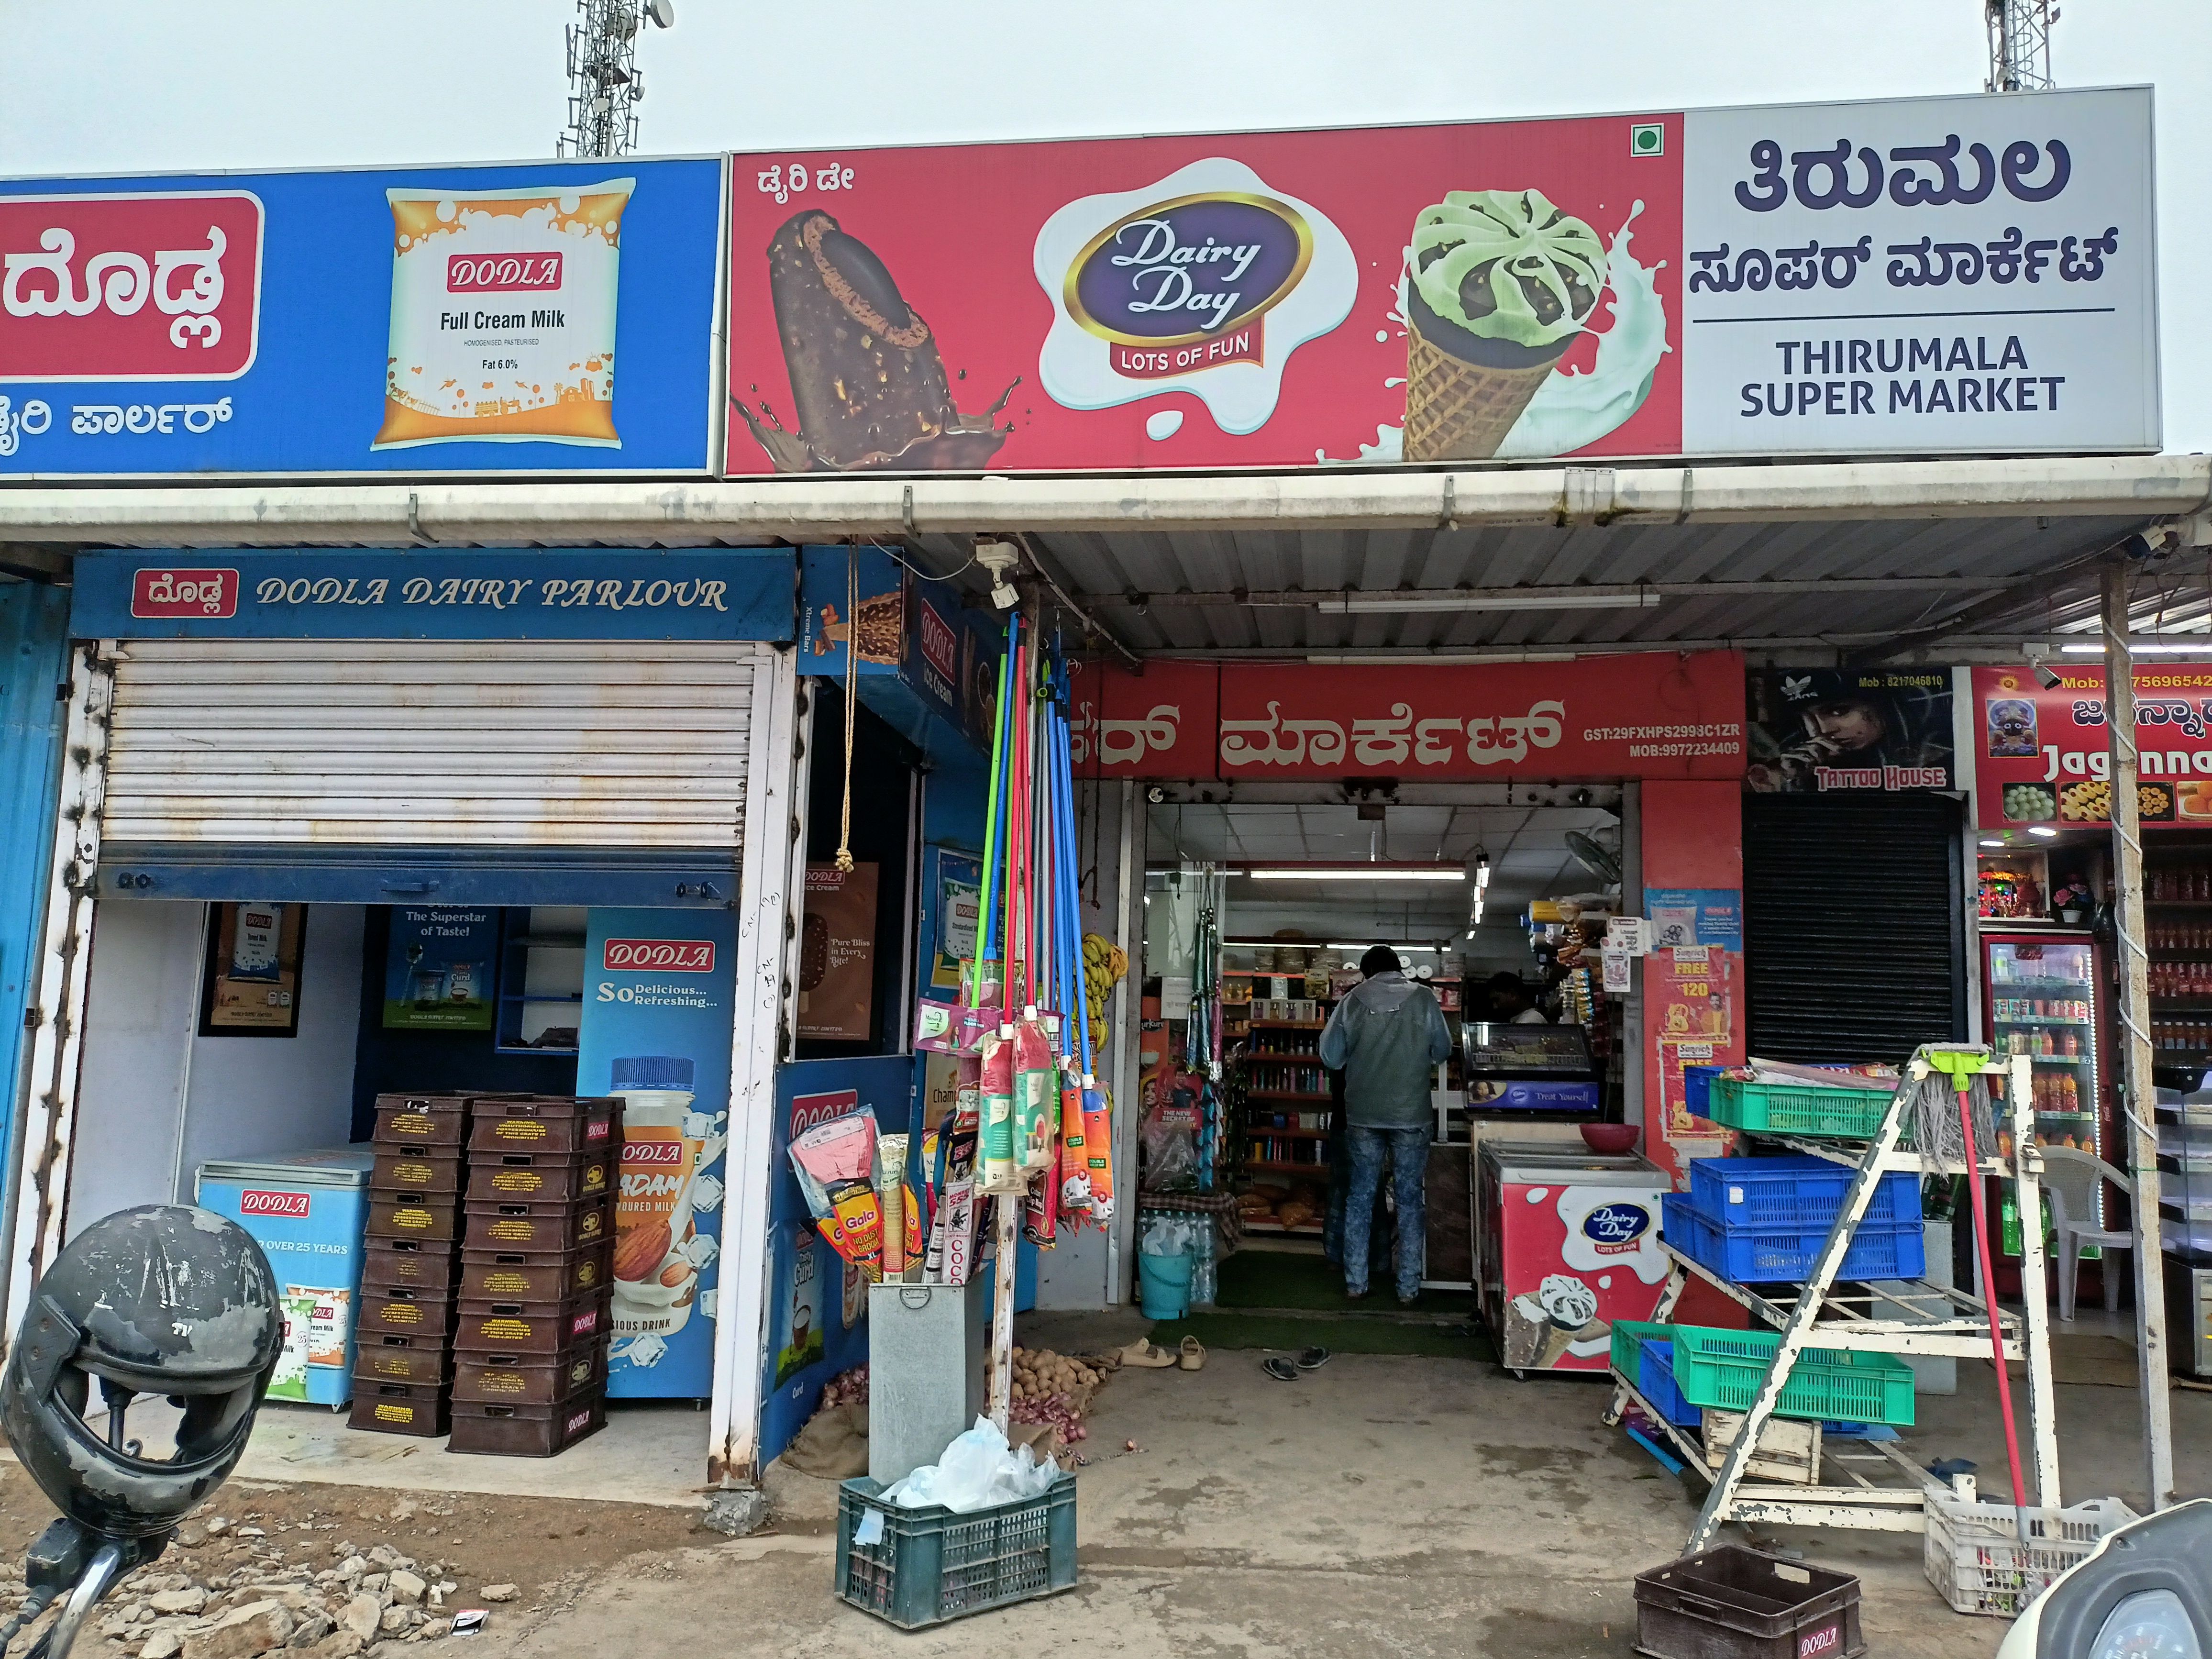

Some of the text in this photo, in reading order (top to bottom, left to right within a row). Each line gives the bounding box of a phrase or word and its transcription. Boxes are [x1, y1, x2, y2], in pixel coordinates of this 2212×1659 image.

[757, 162, 855, 204] ಡೈರಿ ಡೇ
[1734, 134, 2071, 212] ತಿರುಮಲ
[1111, 219, 1261, 282] Dairy
[1689, 226, 2119, 294] ಸೂಪರ್ ಮಾರ್ಕೆಟ್
[451, 258, 559, 286] DODLA
[3, 225, 226, 348] ದೊಡ್ಲ
[1128, 265, 1240, 330] Day
[441, 310, 565, 330] Full Cream Milk
[1121, 332, 1249, 371] LOTS OF FUN
[1776, 335, 2028, 375] THIRUMALA
[482, 359, 518, 369] Fat 6.0%
[1740, 376, 2065, 418] SUPER MARKET
[72, 397, 232, 434] ಪಾರ್ಲರ್
[148, 573, 223, 614] ದೊಡ್ಲ
[256, 577, 728, 611] DODLA DAIRY PARLOUR
[804, 606, 812, 633] Xtreme
[922, 612, 954, 673] DODLA
[934, 673, 952, 707] Cream
[1859, 677, 1879, 687] Mob
[2062, 675, 2212, 688] Mob: 75696542
[1220, 699, 1565, 765] ಮಾರ್ಕೆಟ್
[1630, 742, 1740, 757] MOB:9972234409
[2042, 745, 2212, 783] Jagnna
[406, 911, 486, 923] The Superstar
[421, 927, 433, 935] of
[608, 945, 711, 966] DODLA
[830, 957, 849, 968] Bite!
[841, 948, 866, 960] Every
[1675, 963, 1708, 974] FREE
[596, 982, 707, 1002] So Delicious...
[1683, 983, 1708, 996] 120
[635, 995, 718, 1008] Refreshing...
[588, 1124, 608, 1137] DODLA
[622, 1145, 680, 1161] ODLA
[620, 1173, 684, 1199] ADAM
[244, 1194, 308, 1213] DODLA
[616, 1202, 675, 1212] VOURED MILK
[846, 1210, 874, 1229] Gala
[1593, 1208, 1638, 1228] Dairy
[853, 1229, 879, 1245] NO DUST
[1598, 1221, 1633, 1241] Day
[266, 1241, 295, 1252] OVER
[296, 1243, 310, 1252] 25
[313, 1244, 348, 1254] YEARS
[858, 1239, 879, 1253] BROOM
[868, 1252, 877, 1260] XL
[1623, 1243, 1636, 1251] FUN
[795, 1254, 813, 1287] Curd
[574, 1312, 597, 1333] DODLA
[642, 1318, 670, 1330] DRINK
[298, 1335, 307, 1344] 25
[568, 1410, 589, 1432] DODLA
[1802, 1627, 1836, 1657] DODLA
